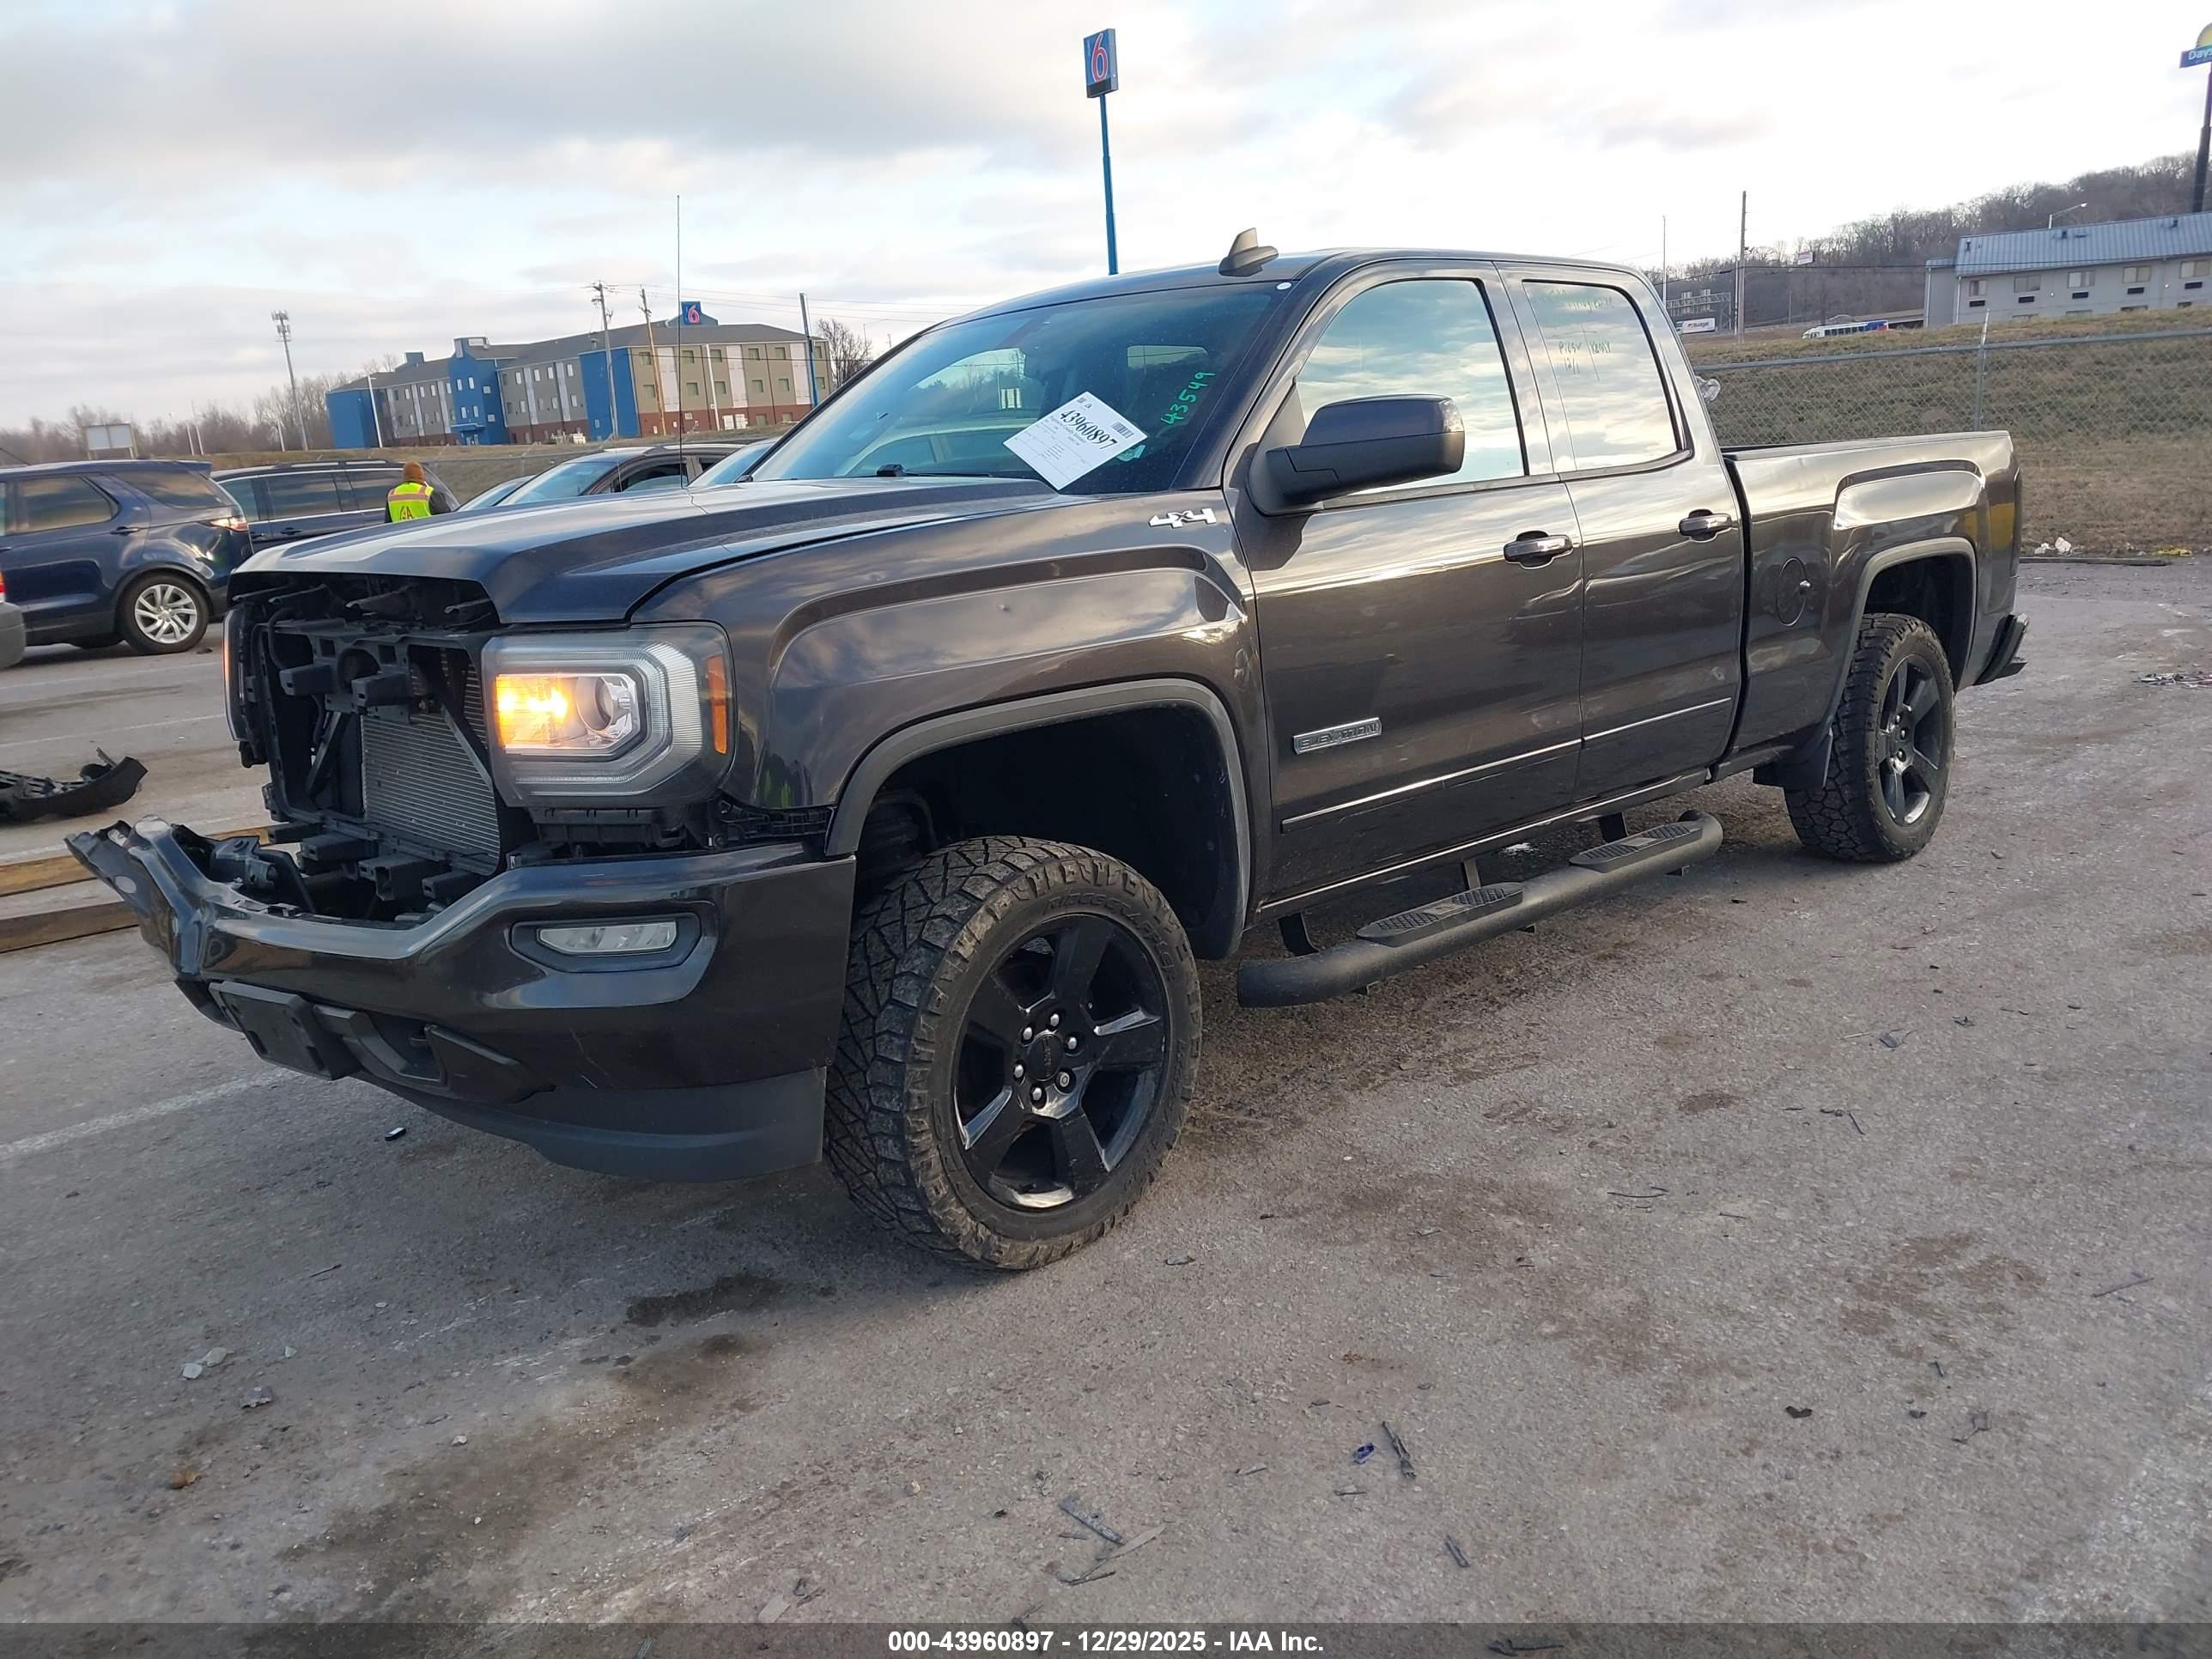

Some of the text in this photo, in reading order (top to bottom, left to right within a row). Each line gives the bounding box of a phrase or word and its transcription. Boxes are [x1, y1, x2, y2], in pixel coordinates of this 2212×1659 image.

[1091, 33, 1109, 83] 6
[688, 304, 700, 324] 6
[1160, 372, 1216, 424] 43549
[1060, 409, 1119, 450] 43960897
